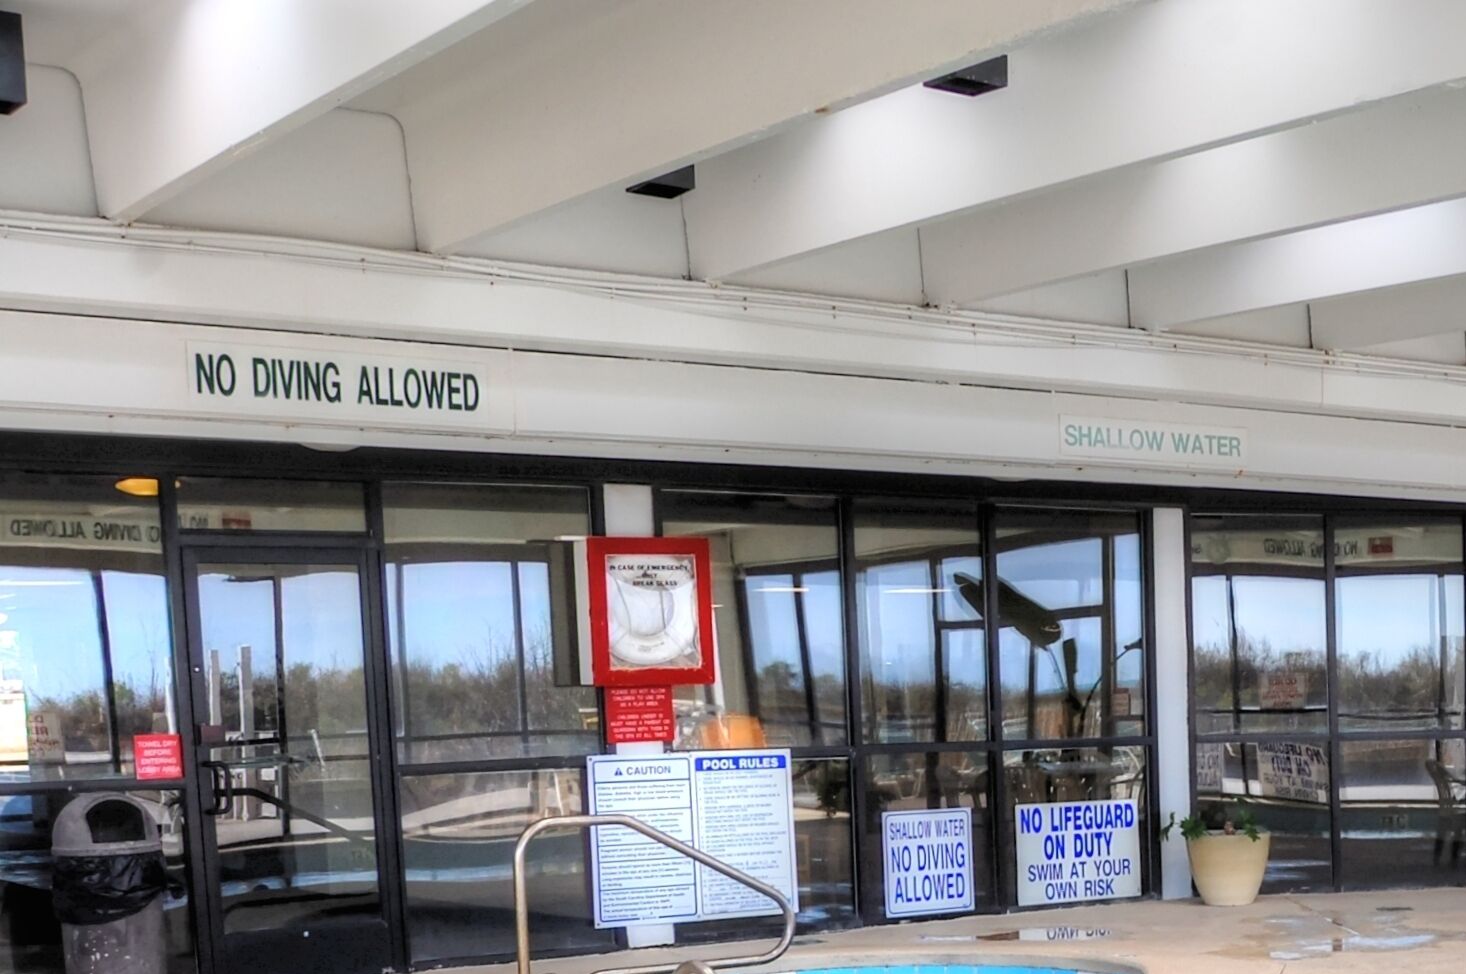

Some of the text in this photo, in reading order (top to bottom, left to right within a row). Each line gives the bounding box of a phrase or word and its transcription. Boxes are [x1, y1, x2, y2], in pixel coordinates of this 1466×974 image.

[195, 353, 479, 411] NO DIVING ALLOWED
[1064, 424, 1241, 457] SHALLOW WATER
[626, 766, 671, 775] CAUTION
[702, 757, 779, 770] POOL RULES
[889, 818, 965, 841] SHALLOW WATER
[1020, 803, 1134, 834] NO LIFEGUARD
[891, 842, 965, 873] NO DIVING
[1044, 832, 1113, 860] ON DUTY
[1028, 858, 1131, 882] SWIM AT YOUR
[894, 873, 965, 904] ALLOWED
[1045, 878, 1115, 900] OWN RISK
